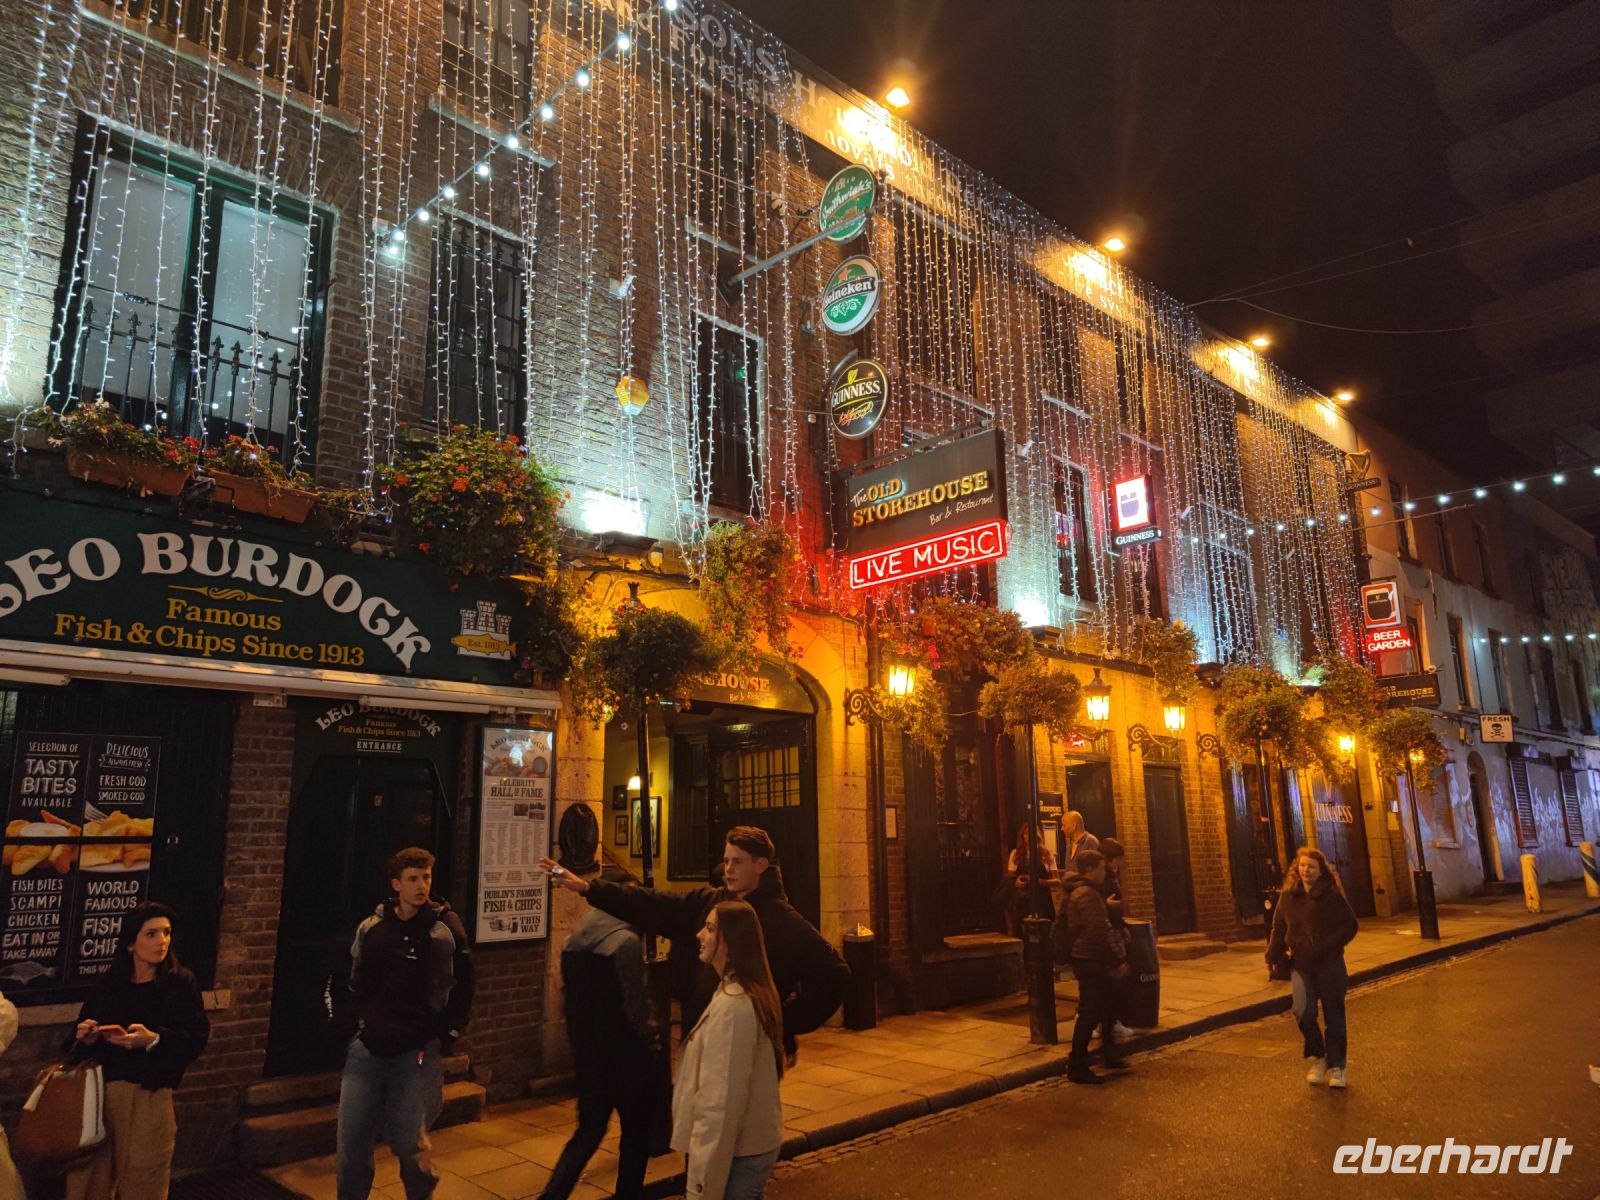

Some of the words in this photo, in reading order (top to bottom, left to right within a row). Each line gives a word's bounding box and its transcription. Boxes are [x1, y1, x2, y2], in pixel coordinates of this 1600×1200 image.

[825, 279, 873, 305] eineken
[832, 380, 881, 408] GUINNESS
[850, 487, 868, 508] The
[866, 478, 902, 502] OLD
[852, 470, 989, 528] STOREHOUSE
[929, 510, 944, 526] Bar
[944, 506, 953, 519] &
[955, 494, 994, 515] Restaurant
[1115, 529, 1155, 545] GUINNESS
[853, 551, 903, 583] LIVE
[913, 530, 995, 568] MUSIC
[136, 531, 432, 672] BURDOCK
[165, 598, 282, 631] Famous
[53, 612, 122, 644] Fish
[126, 621, 152, 646] &
[153, 625, 237, 658] Chips
[242, 630, 314, 662] Since
[318, 642, 365, 667] 1913
[1373, 630, 1402, 641] BEER
[1368, 638, 1411, 652] GARDEN
[314, 703, 355, 731] LEO
[365, 719, 397, 728] Famous
[338, 725, 355, 734] Fish
[362, 726, 385, 737] Chips
[385, 729, 405, 737] Since
[28, 742, 67, 753] SELECTION
[69, 742, 79, 753] OF
[106, 742, 150, 759] DELICIOUS
[356, 740, 402, 751] ENTRANCE
[25, 758, 80, 777] TASTY
[21, 777, 78, 795] BITES
[99, 775, 127, 787] FRESH
[128, 775, 147, 787] COD
[98, 791, 128, 801] SMOKED
[128, 790, 145, 801] COD
[490, 786, 514, 797] HALL
[520, 787, 544, 798] FAME
[22, 797, 72, 808] AVAILABLE
[1315, 802, 1354, 824] UINNESS
[12, 879, 35, 892] FISH
[36, 878, 64, 891] BITES
[87, 880, 140, 895] WORLD
[484, 888, 515, 900] DUBLIN'S
[516, 887, 542, 899] FAMOUS
[10, 895, 62, 911] SCAMPI
[84, 896, 138, 911] FAMOUS
[483, 899, 507, 913] FISH
[514, 899, 542, 912] CHIPS
[8, 913, 60, 927] CHICKEN
[82, 917, 123, 937] FISH
[519, 915, 541, 925] THIS
[520, 924, 540, 934] WAY
[2, 933, 30, 948] EAT
[31, 932, 45, 946] IN
[47, 931, 60, 943] OR
[80, 937, 119, 957] CHI
[2, 949, 27, 961] TAKE
[28, 947, 58, 959] AWAY
[79, 965, 97, 975] THIS
